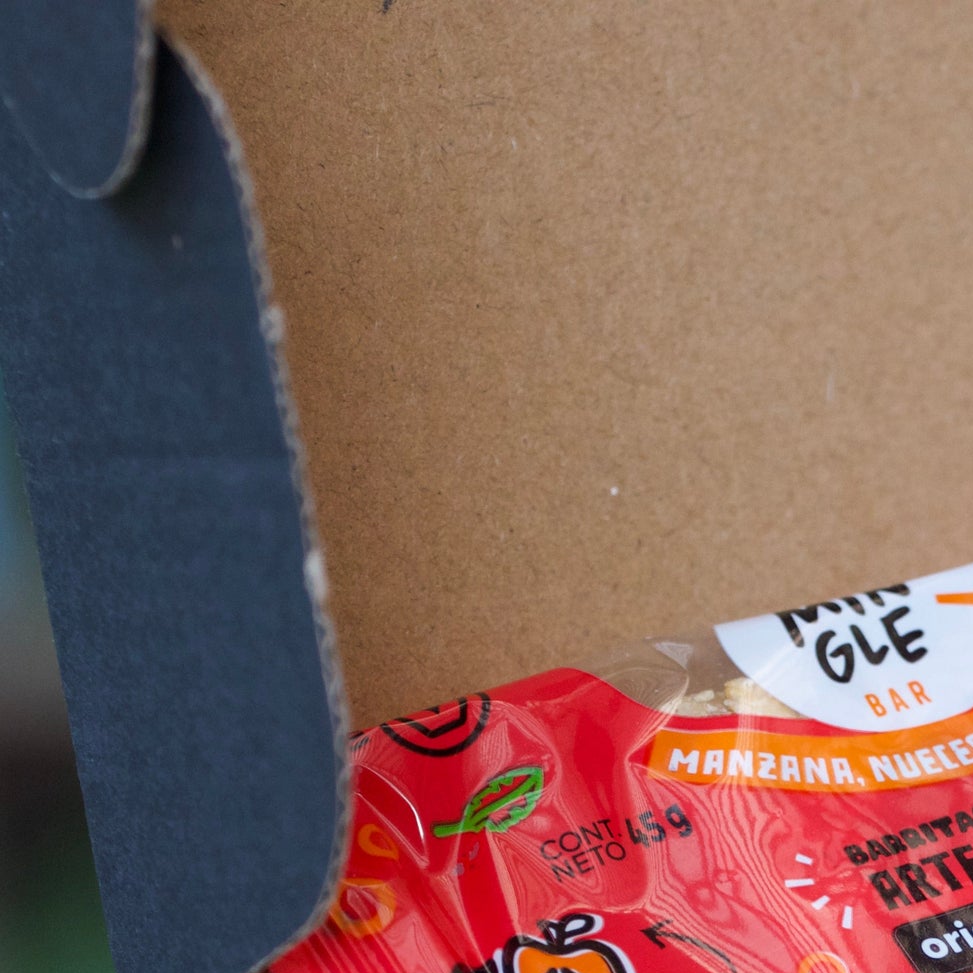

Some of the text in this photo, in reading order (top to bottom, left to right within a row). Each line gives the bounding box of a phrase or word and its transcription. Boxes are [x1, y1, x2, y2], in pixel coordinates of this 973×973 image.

[815, 605, 928, 684] GLE
[864, 680, 932, 718] BAR
[668, 748, 866, 788] MANZANA,
[540, 803, 694, 860] CONT. 45 g
[551, 841, 627, 883] NETO
